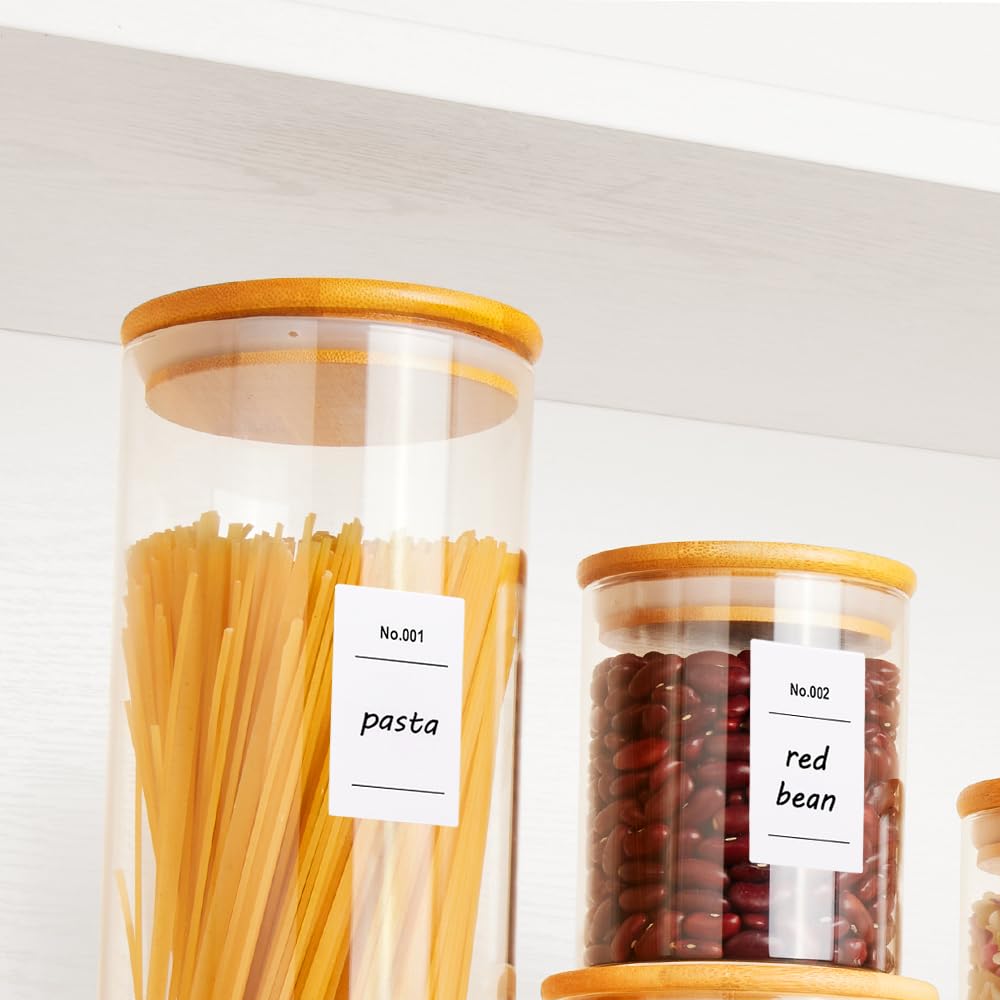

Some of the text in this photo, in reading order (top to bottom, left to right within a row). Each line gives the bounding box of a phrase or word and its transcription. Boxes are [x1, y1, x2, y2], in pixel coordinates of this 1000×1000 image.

[380, 625, 424, 643] No.001
[790, 682, 830, 700] No.002
[359, 711, 439, 737] pasta
[785, 745, 830, 771] red
[775, 780, 837, 812] bean
